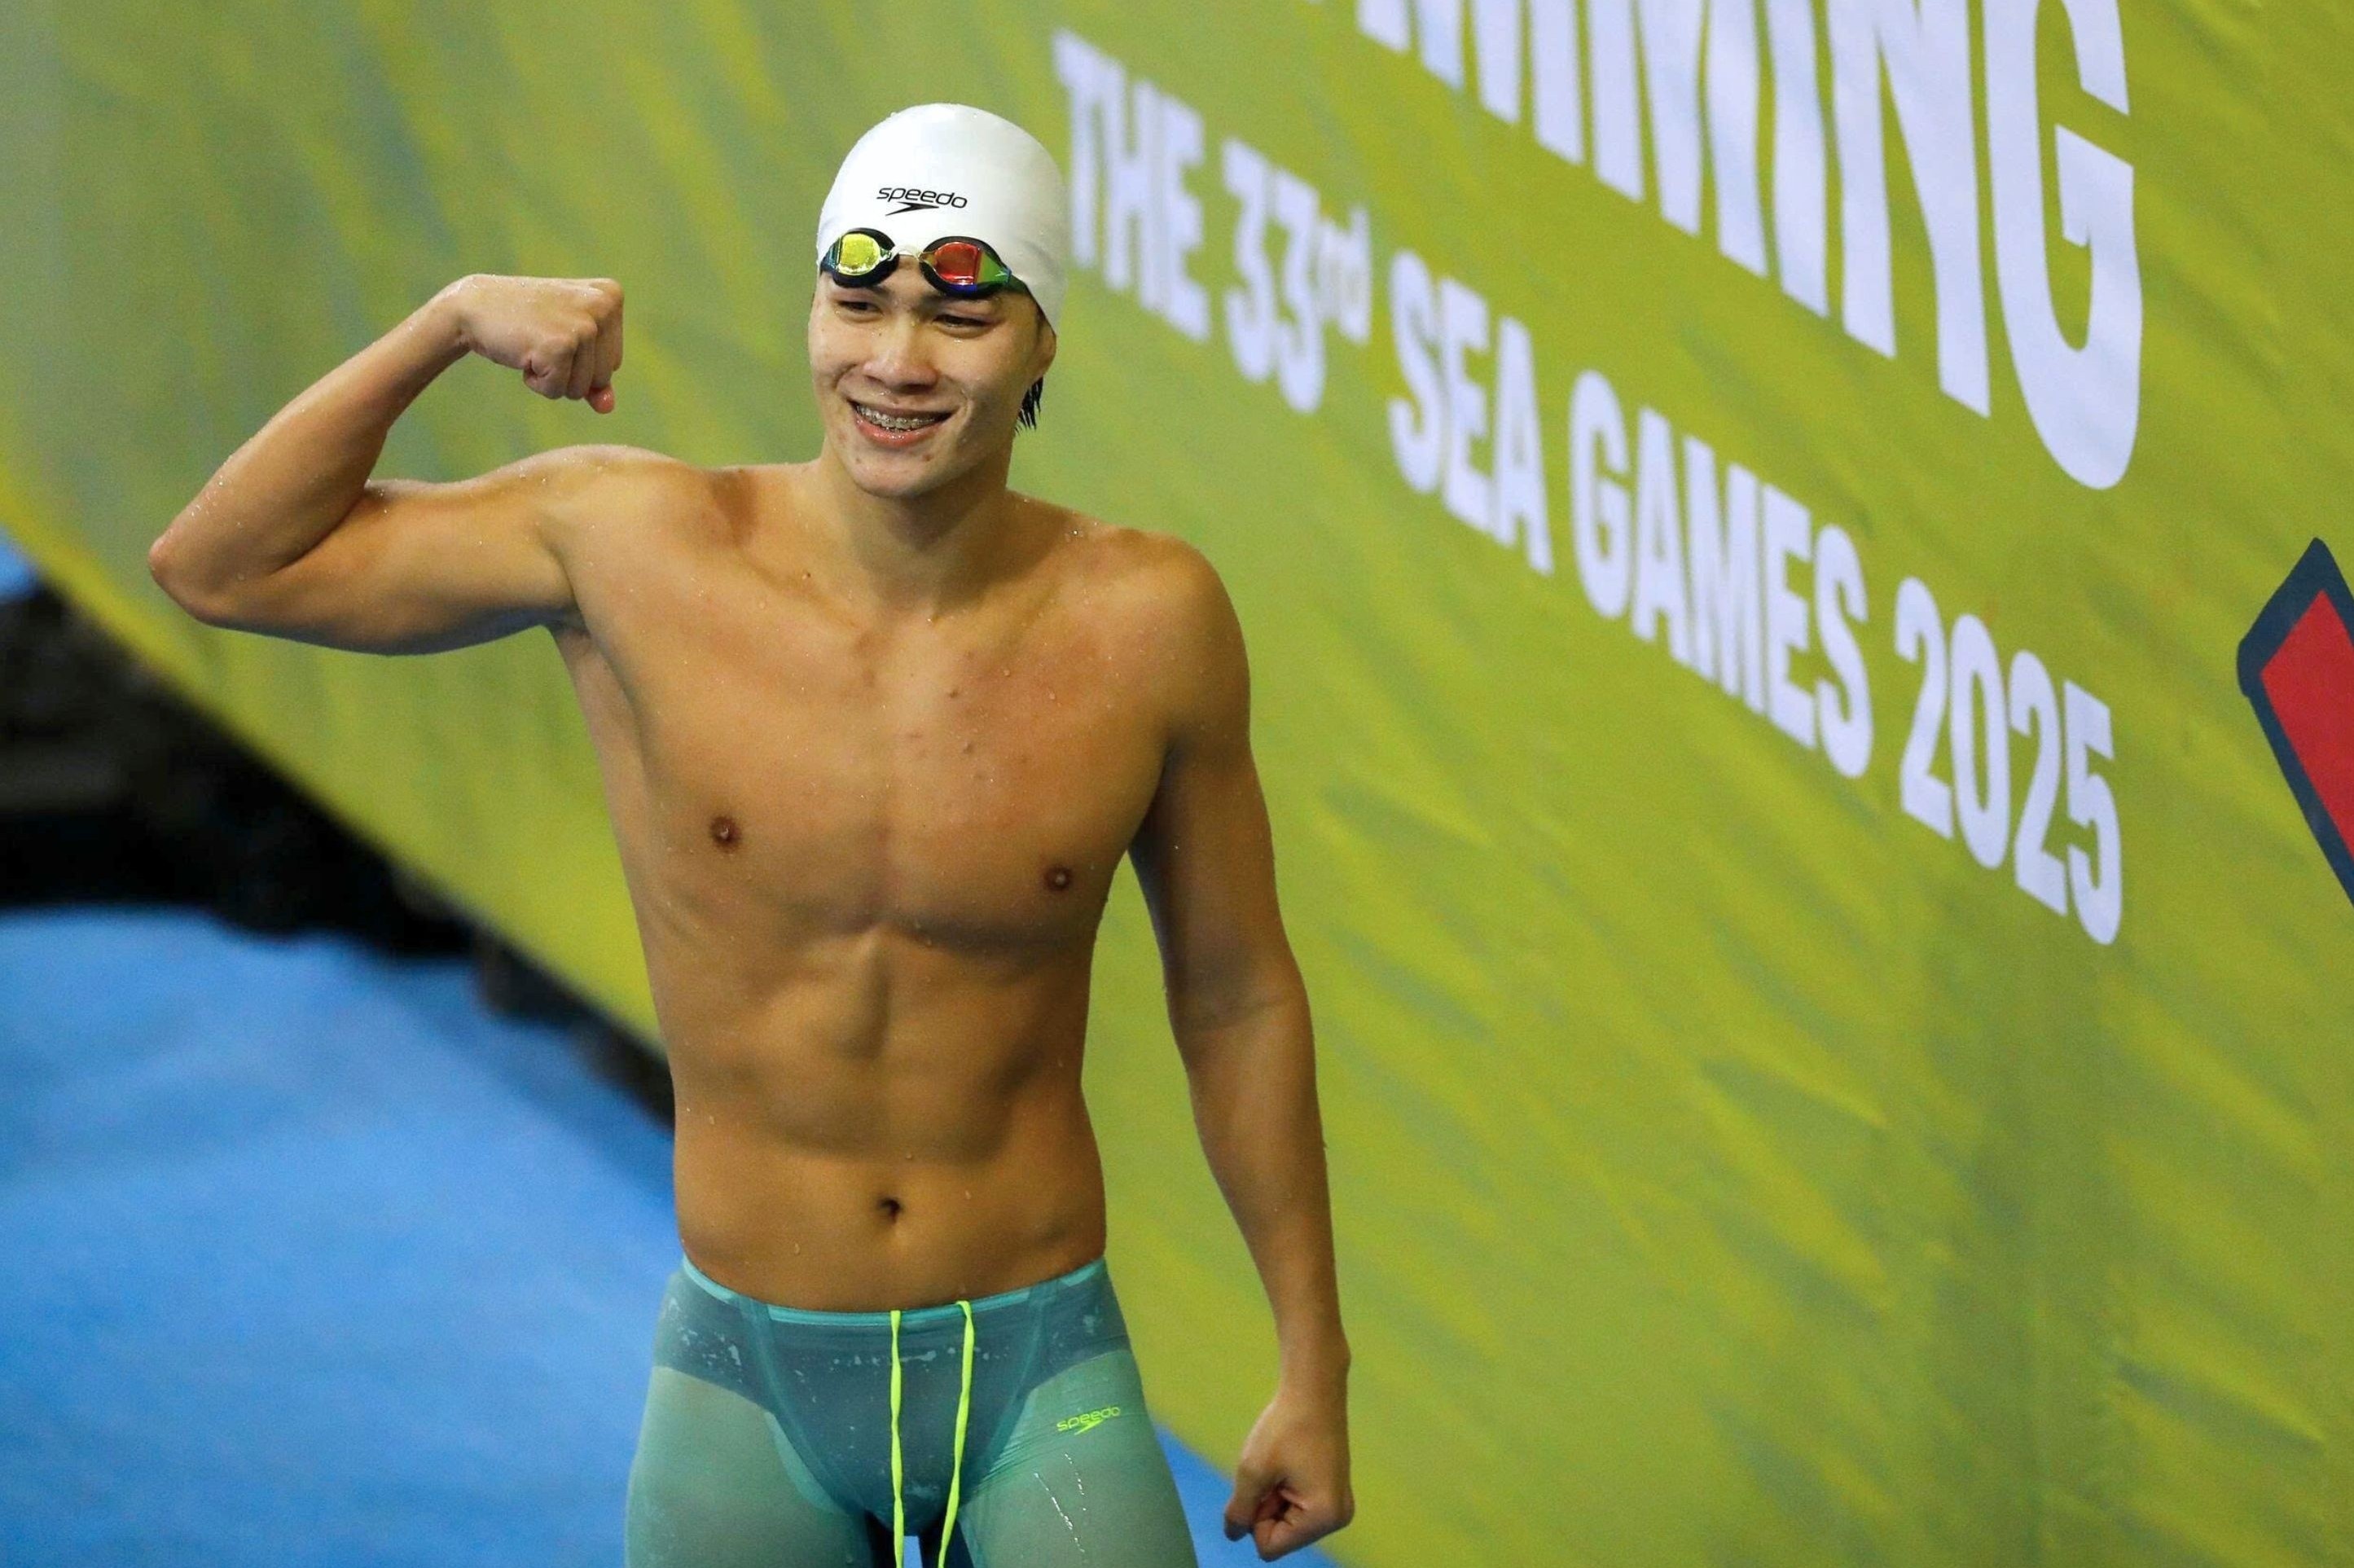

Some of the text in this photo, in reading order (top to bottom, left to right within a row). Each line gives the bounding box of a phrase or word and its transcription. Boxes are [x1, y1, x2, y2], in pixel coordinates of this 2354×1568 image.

[876, 187, 968, 209] speedo
[1051, 29, 2123, 946] THE 33rd SEA GAMES 2025
[1056, 1407, 1121, 1431] speedo
